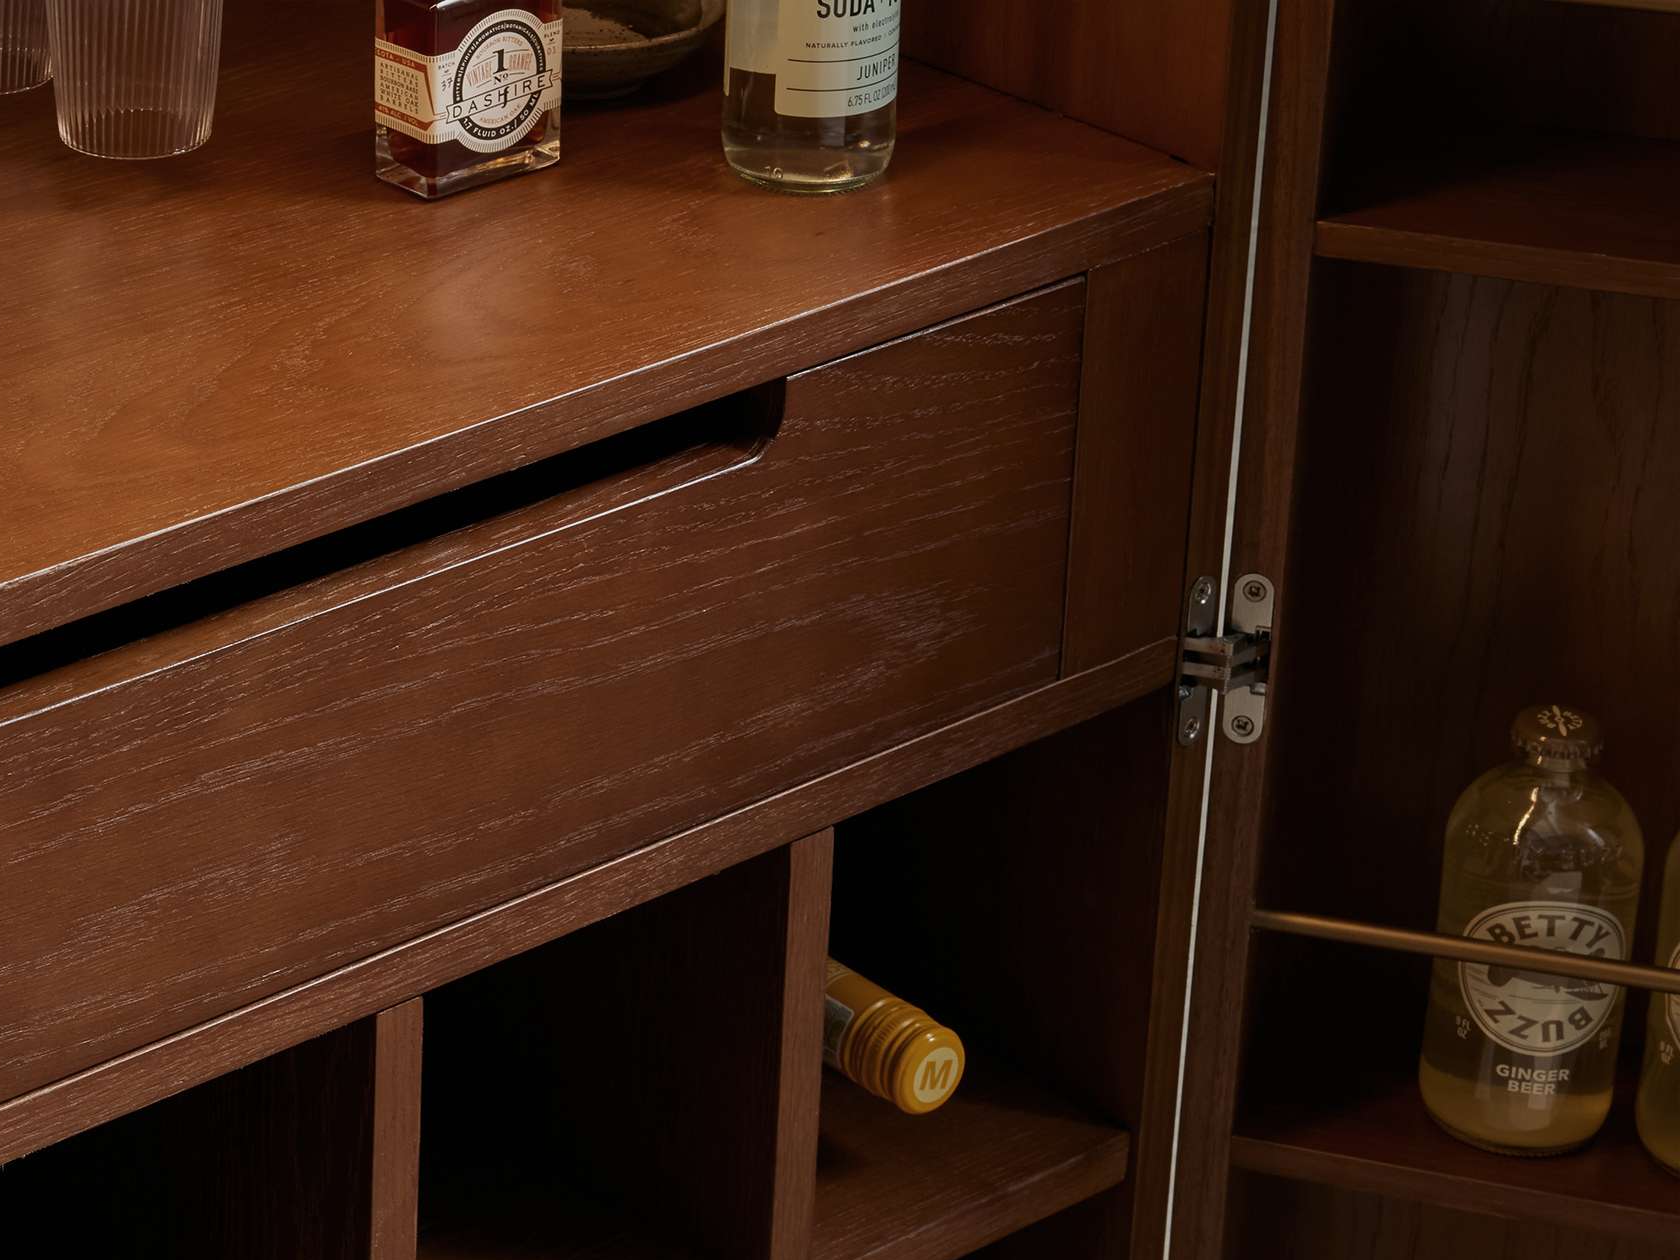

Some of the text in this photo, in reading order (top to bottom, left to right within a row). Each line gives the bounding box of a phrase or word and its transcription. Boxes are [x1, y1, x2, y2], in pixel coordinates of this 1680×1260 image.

[853, 23, 869, 32] with
[806, 35, 881, 49] NATURALLY FLAVORED
[380, 62, 418, 81] ARTISANAL
[857, 53, 895, 80] JUNIPER
[380, 82, 418, 99] AMERICAN
[380, 94, 418, 115] BARRELS
[405, 98, 418, 107] OAK
[473, 126, 497, 137] FLUID
[1486, 914, 1611, 948] BETTY
[1484, 1000, 1594, 1042] BUZZ
[919, 1060, 953, 1090] M
[1496, 1064, 1569, 1081] GINGER
[1507, 1080, 1556, 1095] BEER
